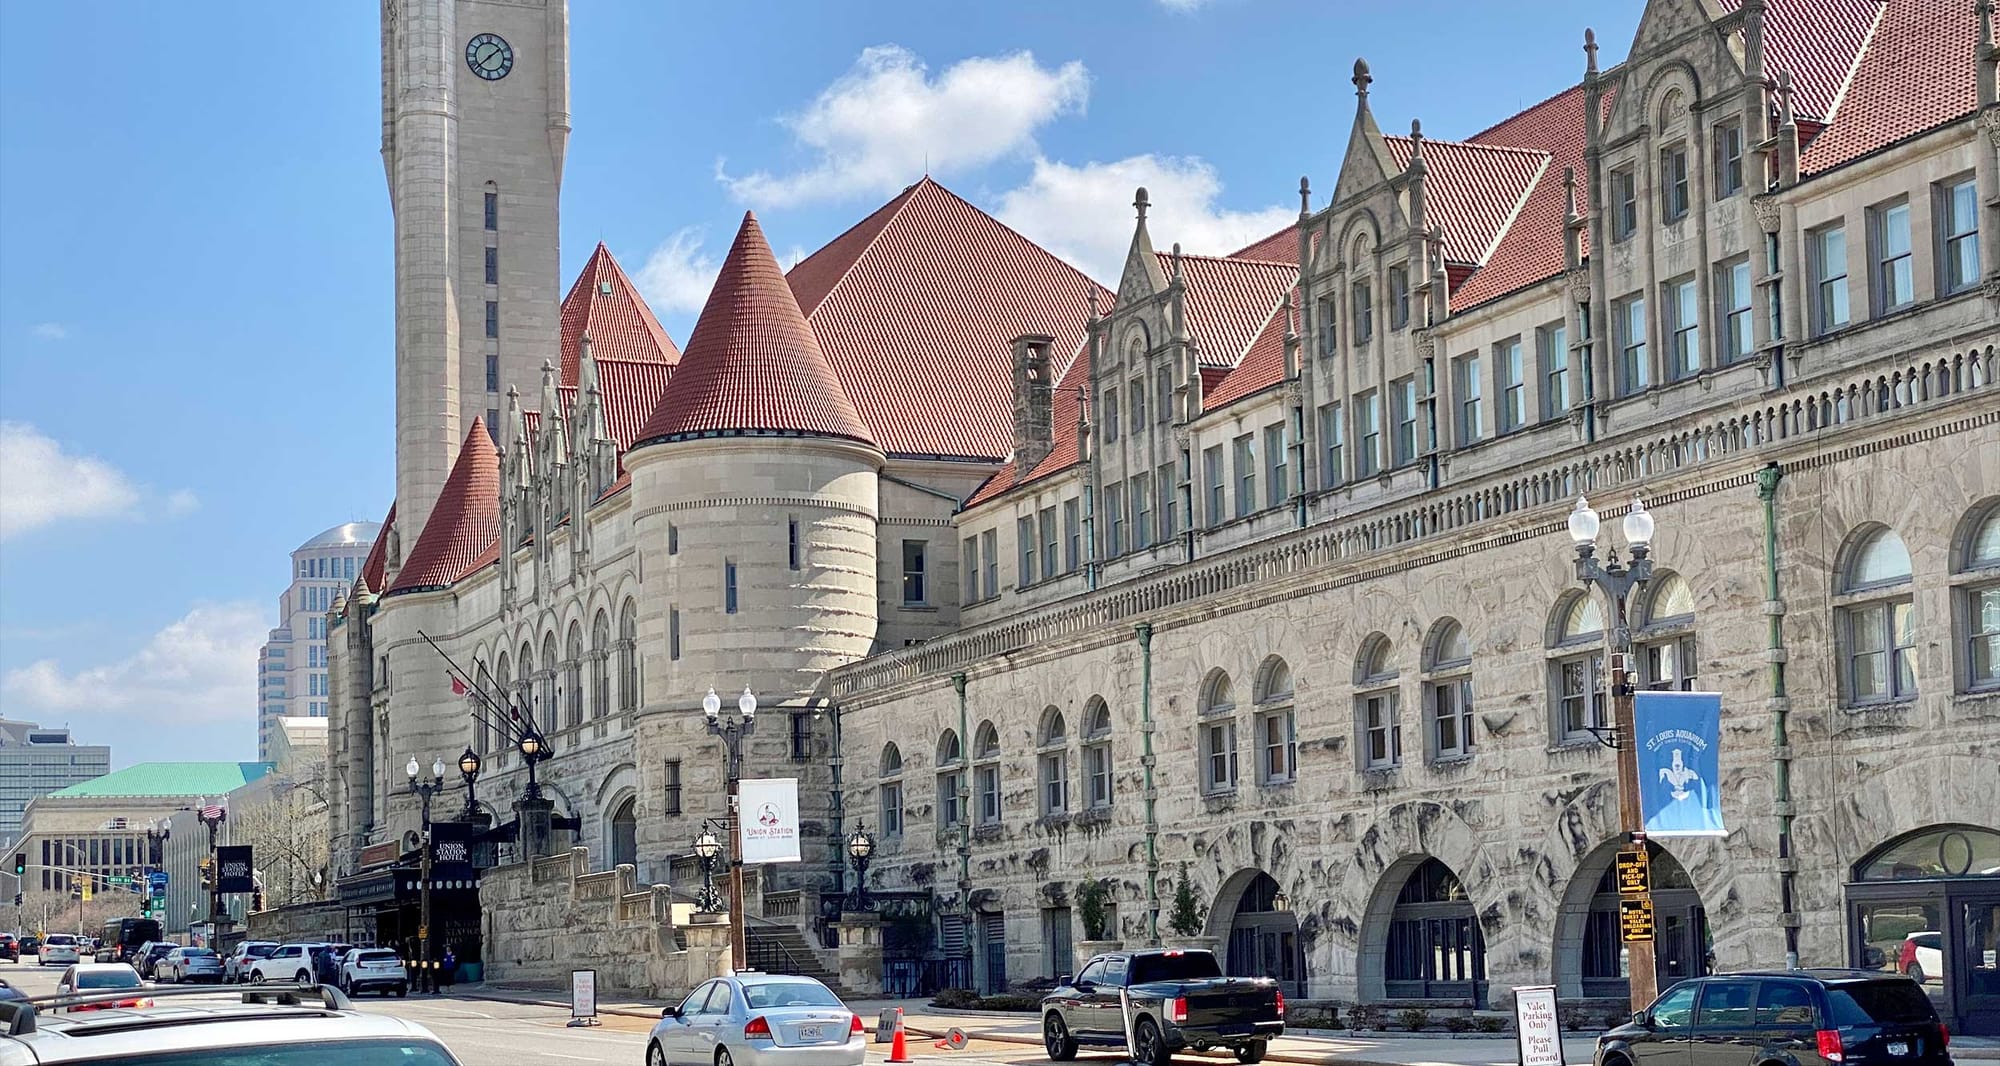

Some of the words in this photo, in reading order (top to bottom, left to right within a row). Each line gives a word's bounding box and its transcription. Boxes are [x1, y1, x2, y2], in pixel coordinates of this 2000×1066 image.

[1656, 729, 1674, 743] LOUIS
[1675, 729, 1708, 750] AQUARIUM
[746, 827, 767, 836] UNION
[769, 827, 793, 835] STATION
[1526, 1002, 1546, 1010] Valet
[1523, 1010, 1553, 1022] Parking
[1529, 1020, 1548, 1031] Only
[1529, 1036, 1552, 1045] Please
[1533, 1044, 1549, 1054] Pull
[1526, 1052, 1558, 1063] Forward
